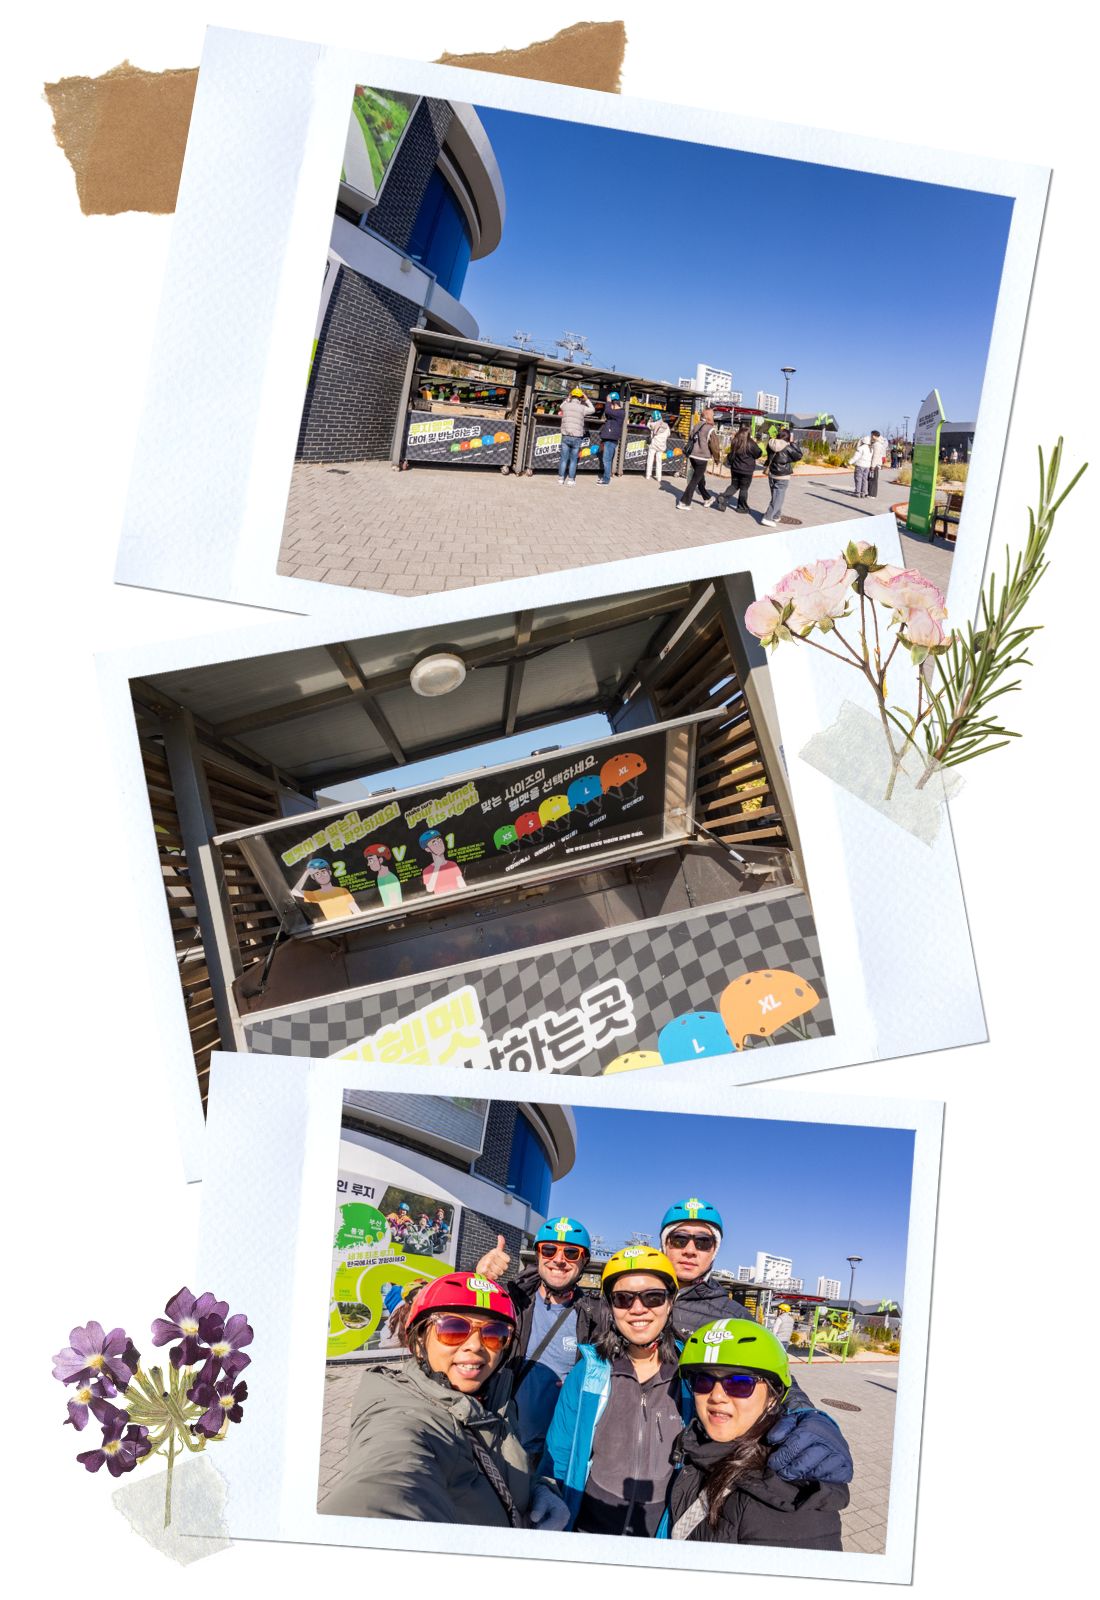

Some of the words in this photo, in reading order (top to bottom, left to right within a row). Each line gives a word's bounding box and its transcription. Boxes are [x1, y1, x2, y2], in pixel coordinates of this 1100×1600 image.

[618, 767, 629, 777] XL
[480, 796, 502, 814] 맞는
[505, 768, 545, 801] 사이즈의
[508, 786, 540, 812] 헬멧을
[542, 755, 599, 793] 선택하세요.
[584, 787, 590, 795] L
[406, 805, 433, 828] your
[433, 781, 475, 810] helmet
[528, 820, 534, 828] S
[445, 832, 455, 849] 1
[502, 832, 513, 842] XS
[392, 845, 407, 862] V
[332, 861, 347, 878] 2
[757, 994, 782, 1015] XL
[587, 984, 630, 1044] 곳
[692, 1039, 705, 1054] L
[351, 1183, 375, 1199] 루지
[703, 1330, 735, 1345] Luge
